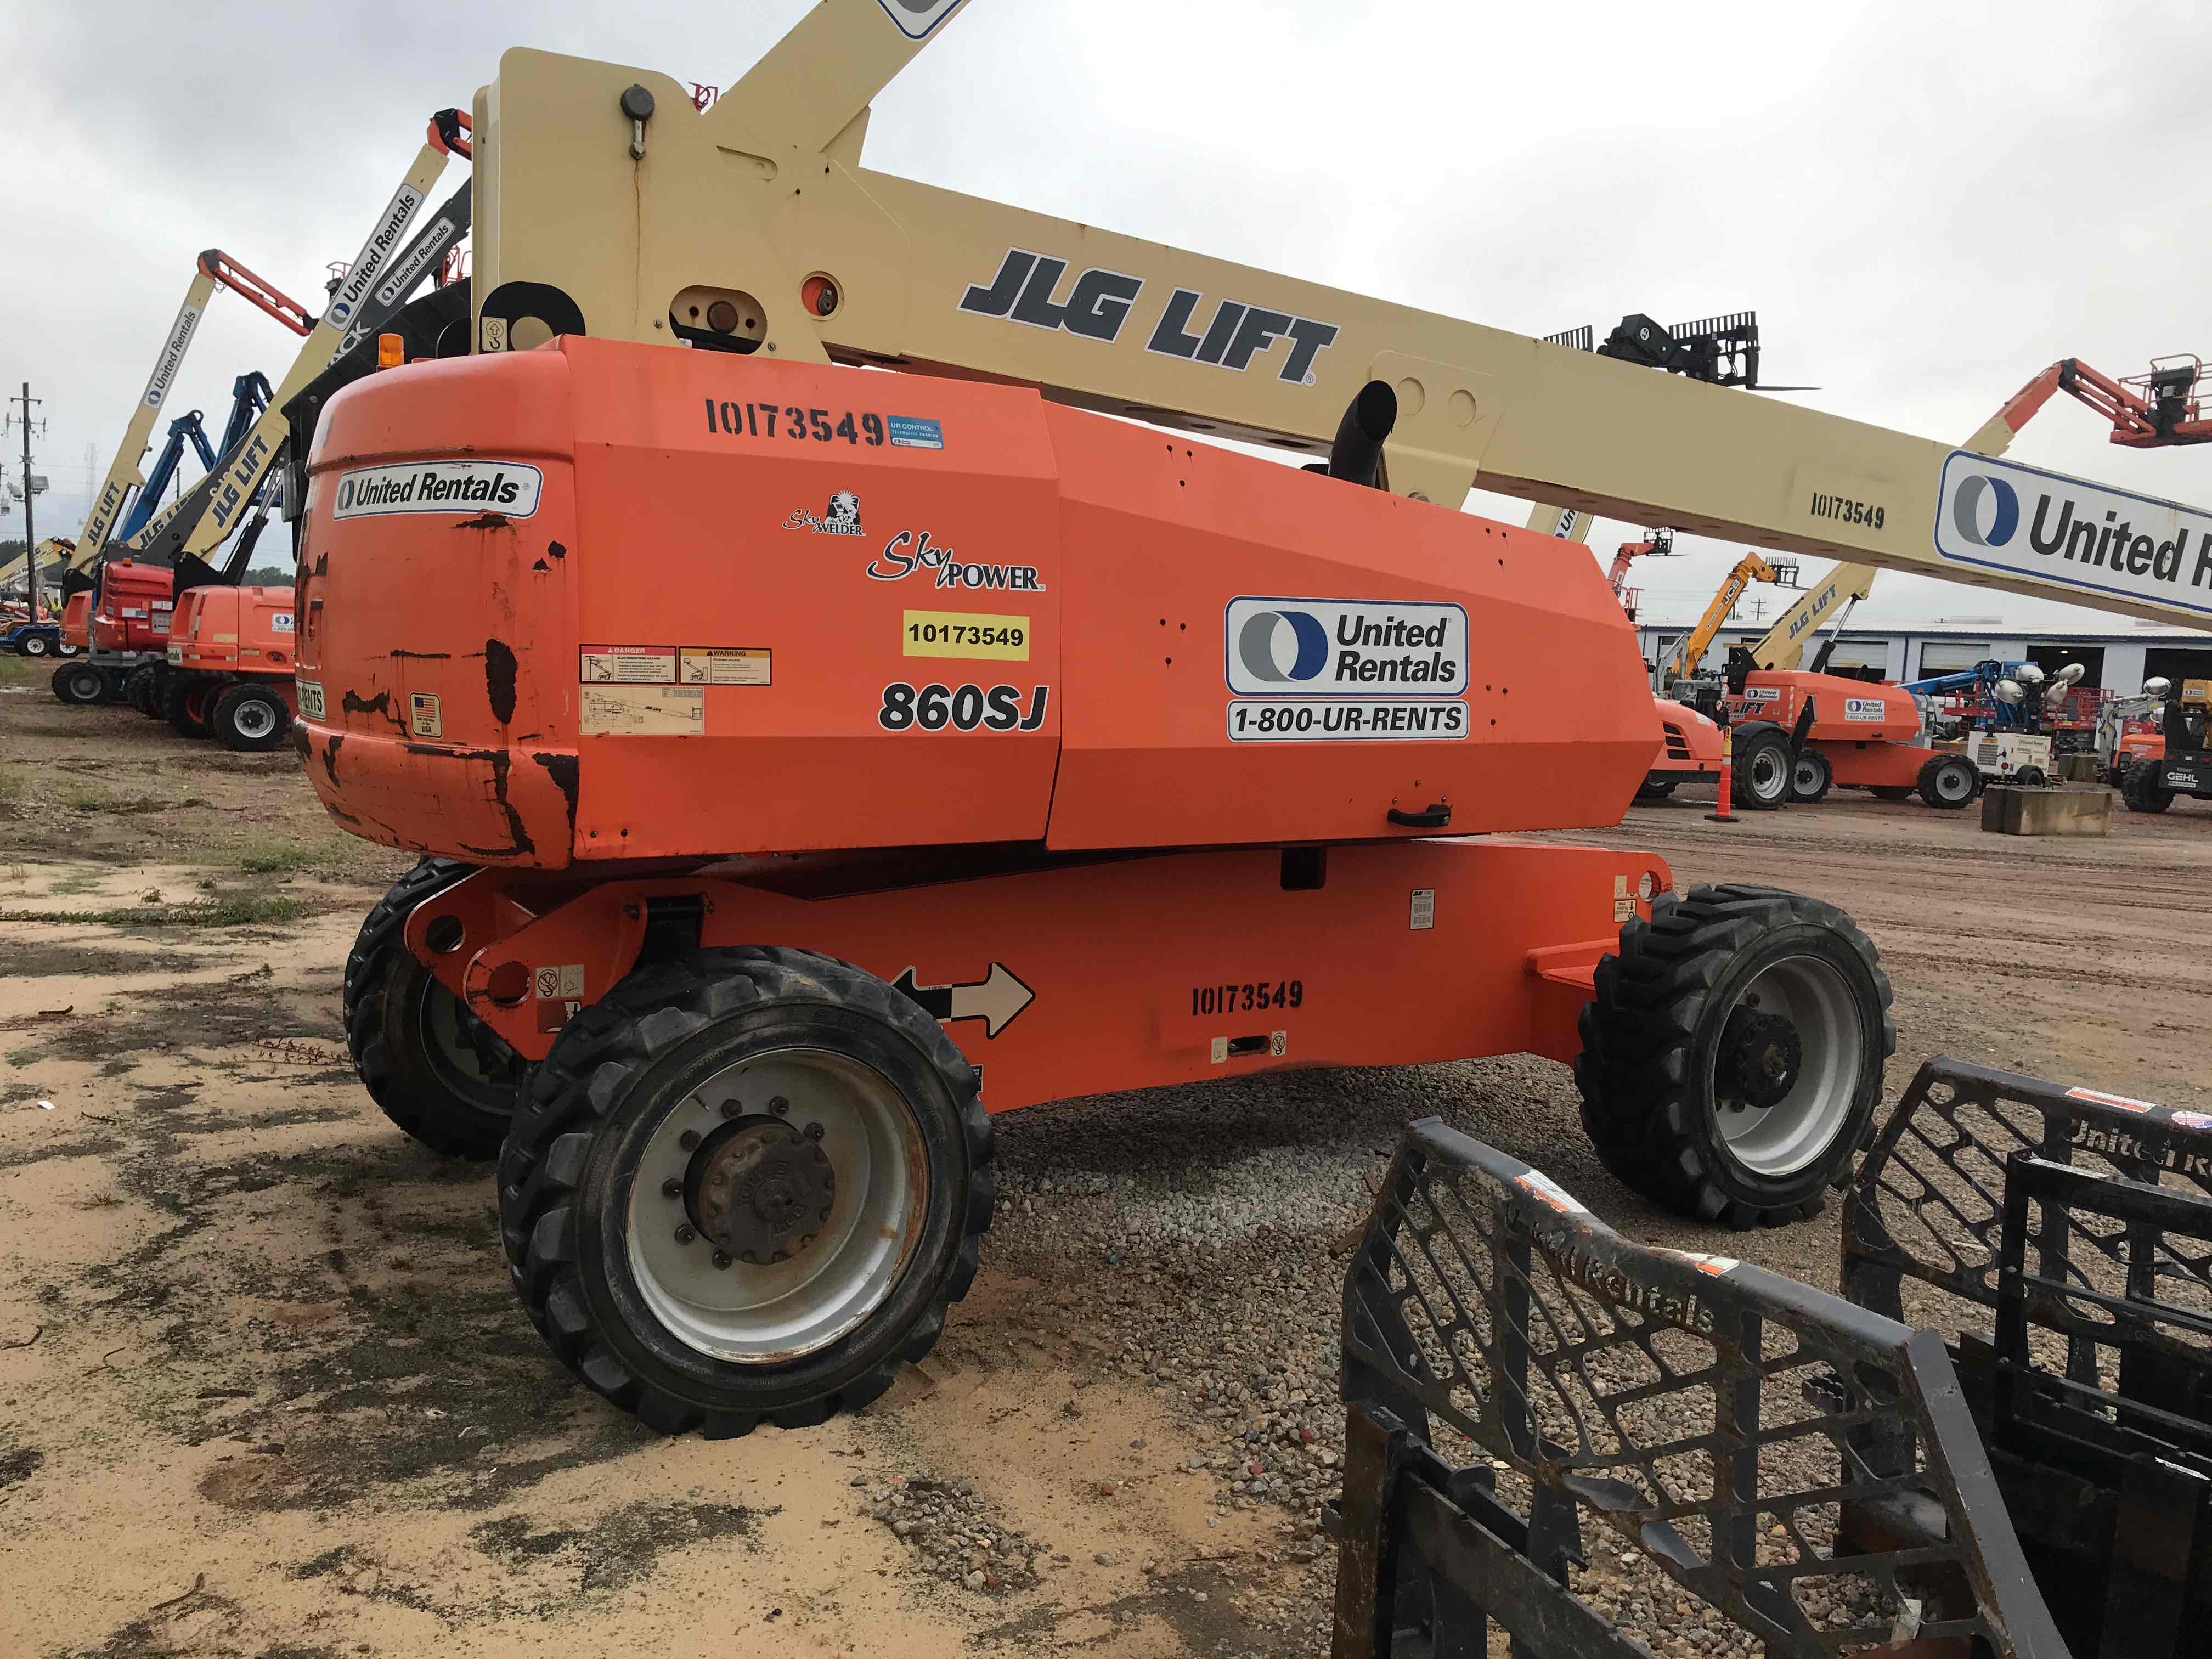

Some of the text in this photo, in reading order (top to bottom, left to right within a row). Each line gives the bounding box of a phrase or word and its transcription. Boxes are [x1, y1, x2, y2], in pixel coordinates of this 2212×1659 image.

[343, 194, 415, 302] United Rentals
[392, 225, 449, 288] United Rentals
[957, 247, 1340, 385] JLG LIFT
[155, 311, 196, 389] United Rentals
[705, 399, 884, 446] 10173549
[901, 423, 934, 431] CONTROL
[212, 433, 269, 529] JLG LIFT
[357, 472, 520, 506] United Rentals
[87, 481, 120, 547] JLG LIFT
[1810, 492, 1884, 529] 10173549
[139, 518, 165, 549] JLG
[2030, 494, 2189, 583] United
[1722, 579, 1740, 605] JCB
[1787, 583, 1837, 640] JLG LIFT
[909, 623, 1023, 646] 10173549
[1336, 614, 1448, 647] United
[1335, 650, 1457, 682] Rentals
[879, 682, 1049, 731] 860SJ
[1235, 706, 1462, 732] 1-800-UR-RENTS
[2167, 772, 2199, 782] GEHL
[1192, 980, 1303, 1016] 10173549
